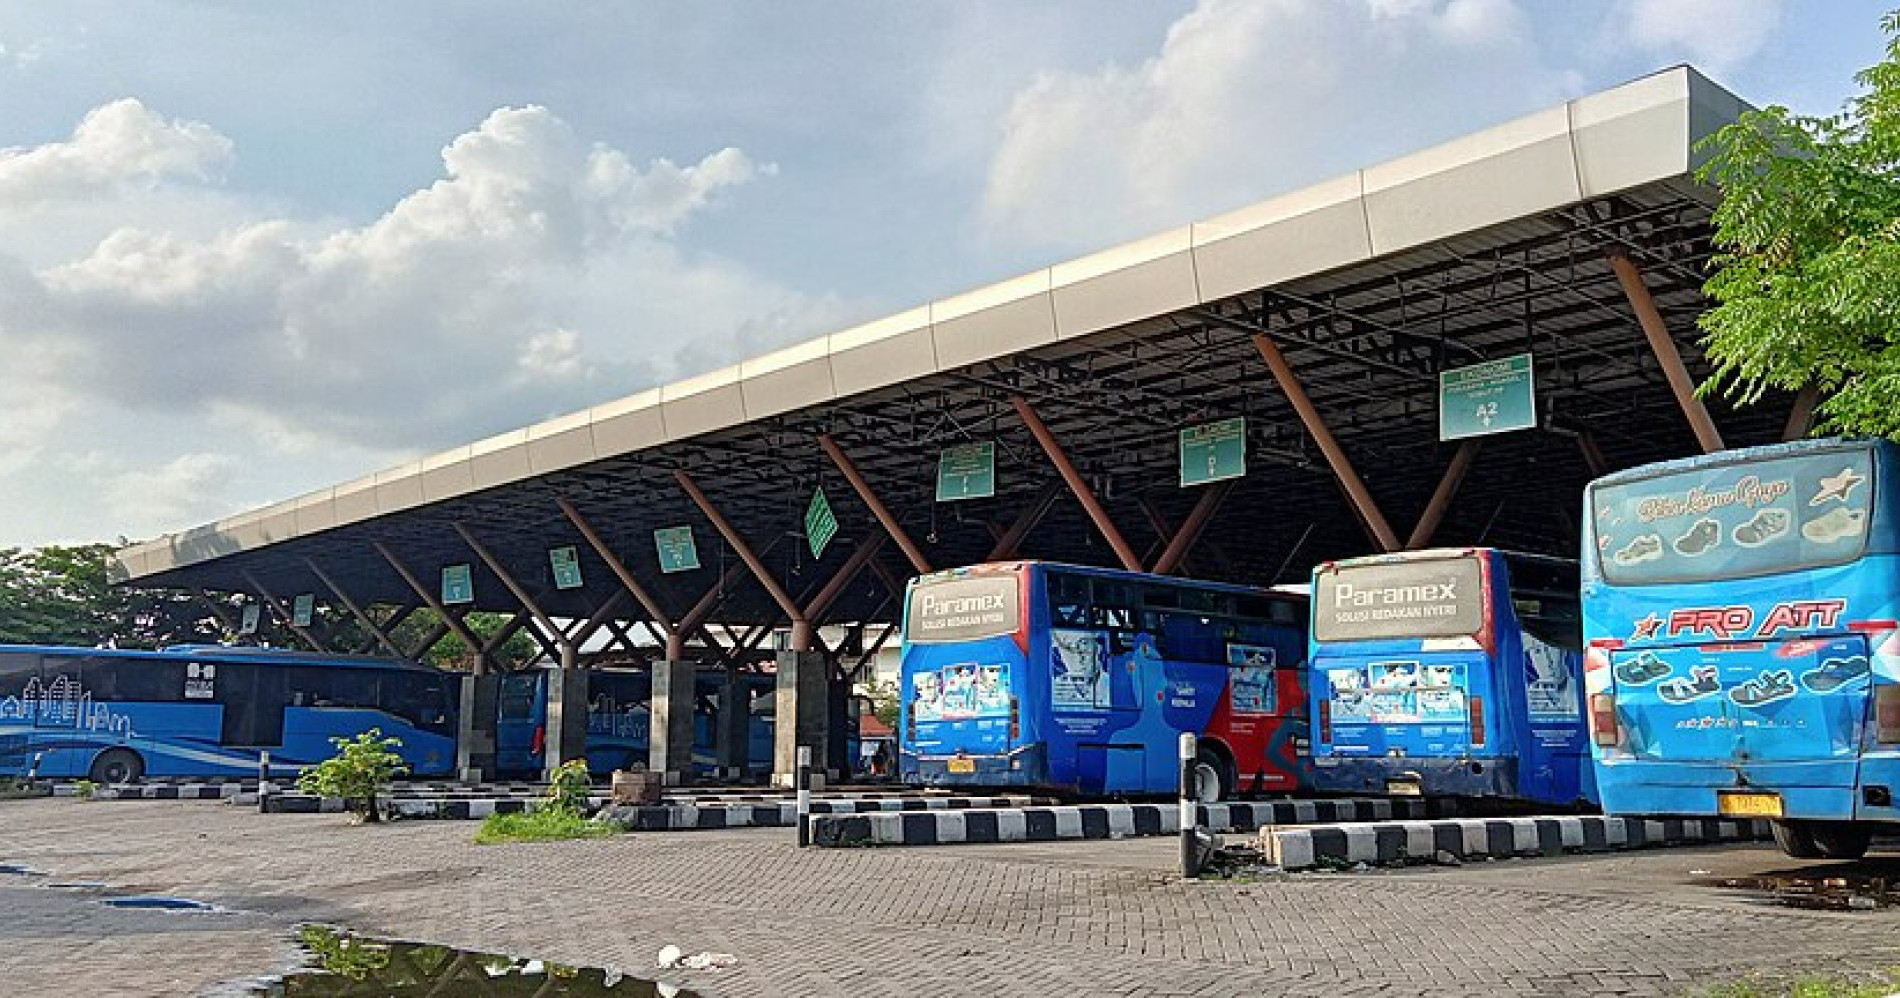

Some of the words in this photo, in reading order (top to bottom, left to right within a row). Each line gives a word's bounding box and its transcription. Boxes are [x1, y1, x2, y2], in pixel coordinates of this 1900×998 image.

[1476, 402, 1499, 417] A2
[921, 594, 1004, 617] Paramex
[1335, 583, 1457, 609] Paramex
[1667, 605, 1754, 640] PRO
[1754, 598, 1847, 637] ATT
